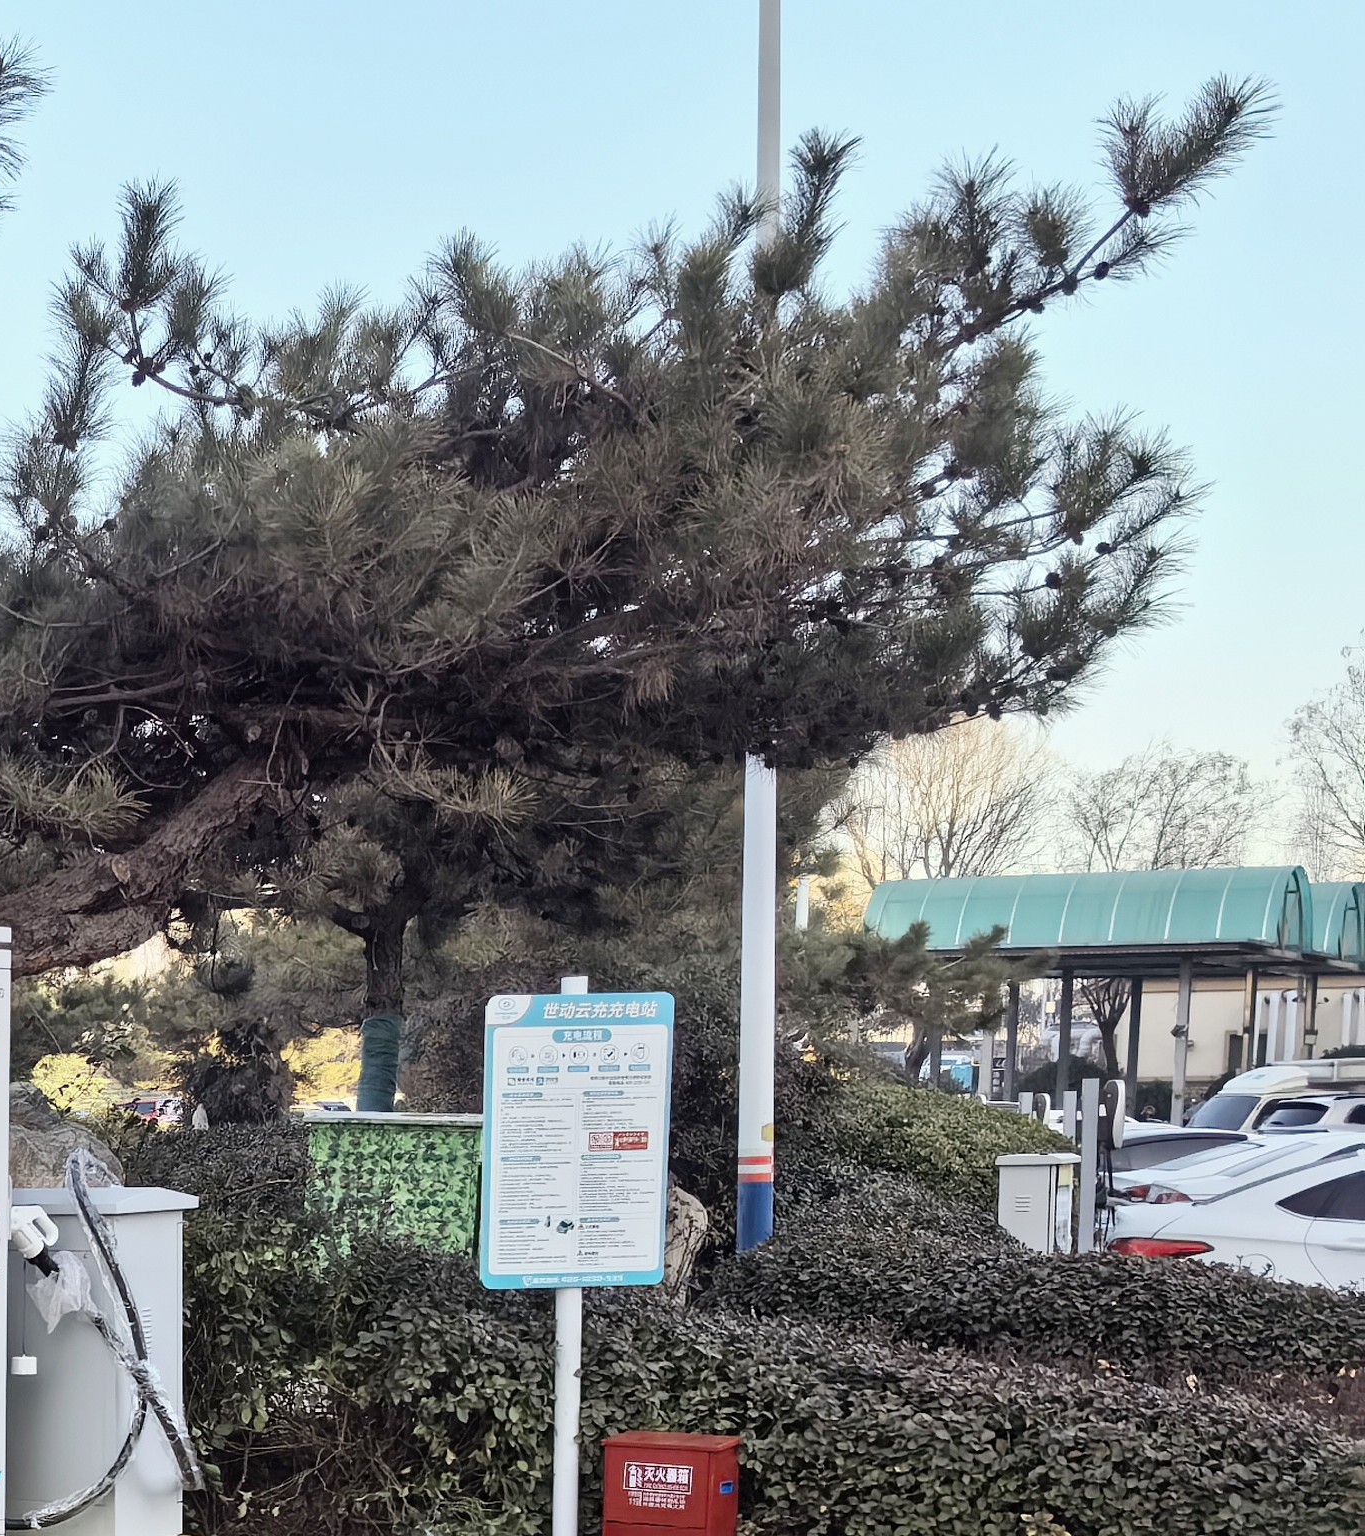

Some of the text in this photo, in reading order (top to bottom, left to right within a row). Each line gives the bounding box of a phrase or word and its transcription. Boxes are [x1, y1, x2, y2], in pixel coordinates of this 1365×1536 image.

[543, 1001, 658, 1020] 世动云充充电站
